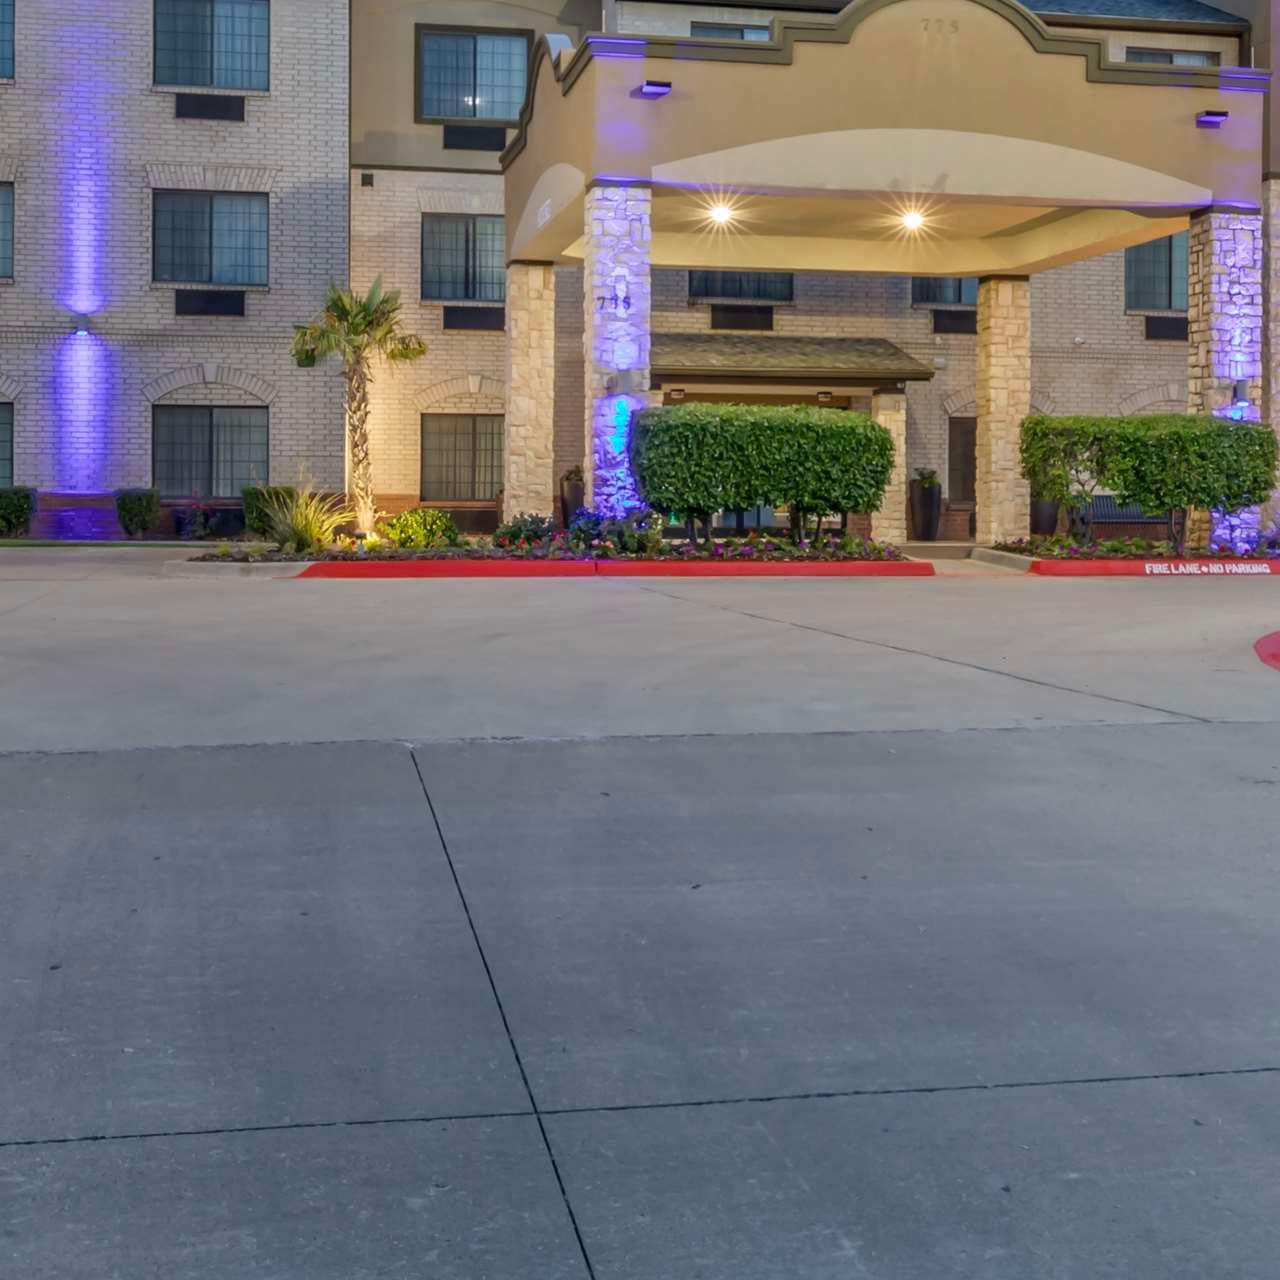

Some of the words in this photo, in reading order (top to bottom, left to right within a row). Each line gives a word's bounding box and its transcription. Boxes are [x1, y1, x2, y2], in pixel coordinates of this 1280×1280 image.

[1145, 563, 1171, 574] FIRE
[1170, 563, 1202, 574] LANE
[1209, 563, 1224, 574] NO
[1225, 563, 1271, 574] PARKING
